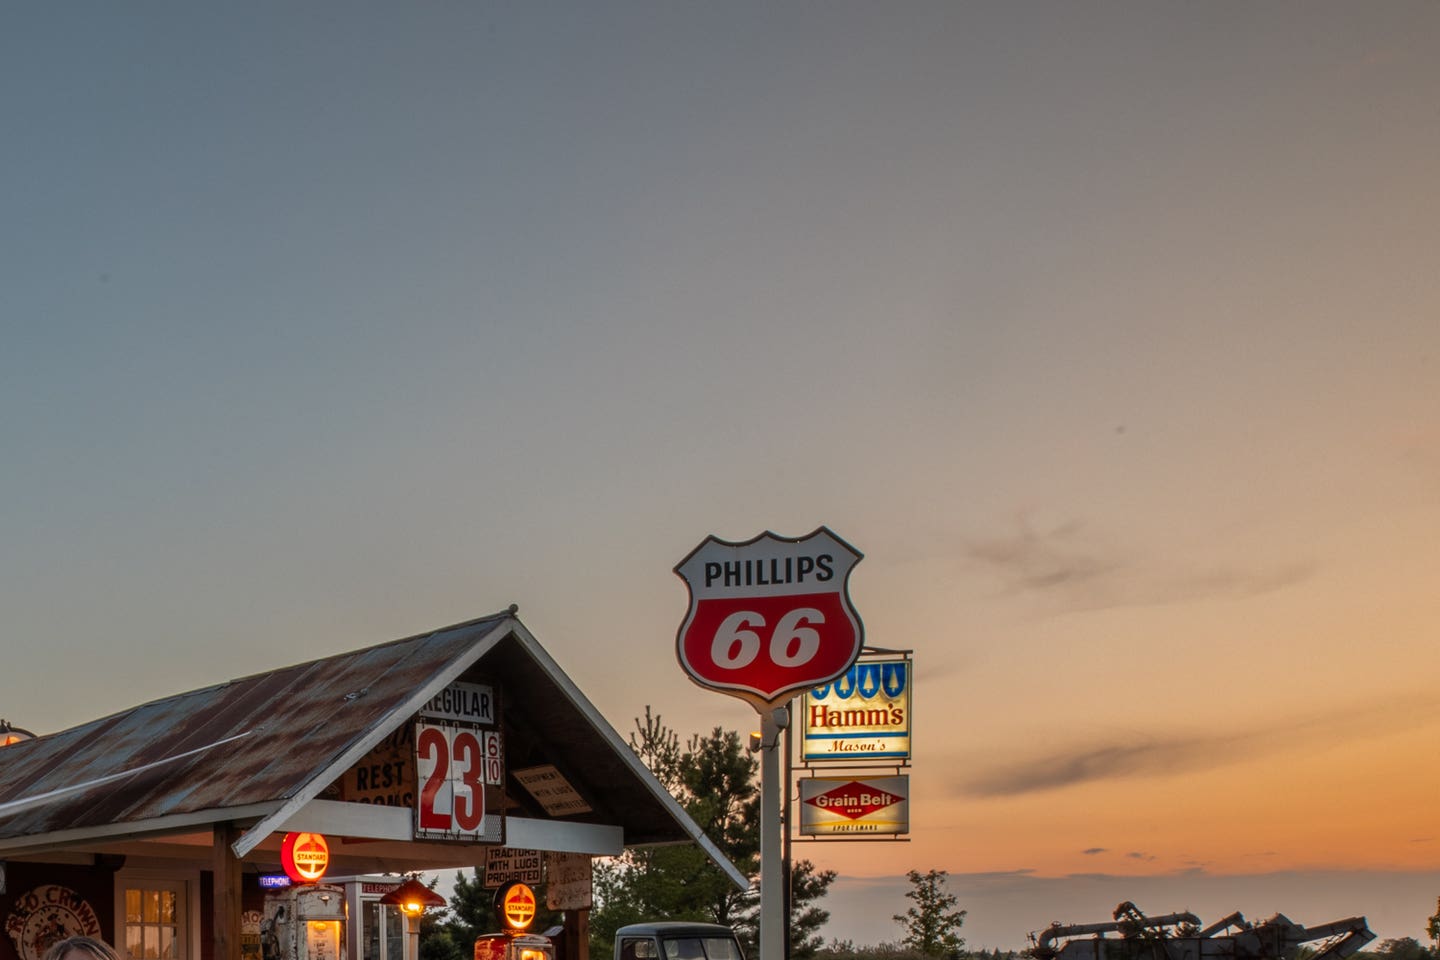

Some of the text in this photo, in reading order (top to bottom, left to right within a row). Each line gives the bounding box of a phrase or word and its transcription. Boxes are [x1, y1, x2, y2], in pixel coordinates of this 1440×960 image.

[705, 554, 834, 588] PHILLIPS
[710, 607, 826, 670] 66
[423, 688, 491, 718] REGULAR
[810, 703, 904, 728] Hamm's
[828, 739, 886, 752] Mason's
[357, 762, 406, 792] REST
[418, 728, 484, 831] 23
[815, 793, 892, 808] Grain Belt
[296, 853, 326, 861] STANDARD
[489, 847, 537, 859] TRACTORS
[488, 858, 538, 871] WITH LUGS
[260, 876, 291, 886] TELEPHONE
[487, 870, 539, 883] PROHIBITED
[46, 886, 99, 936] CROWN
